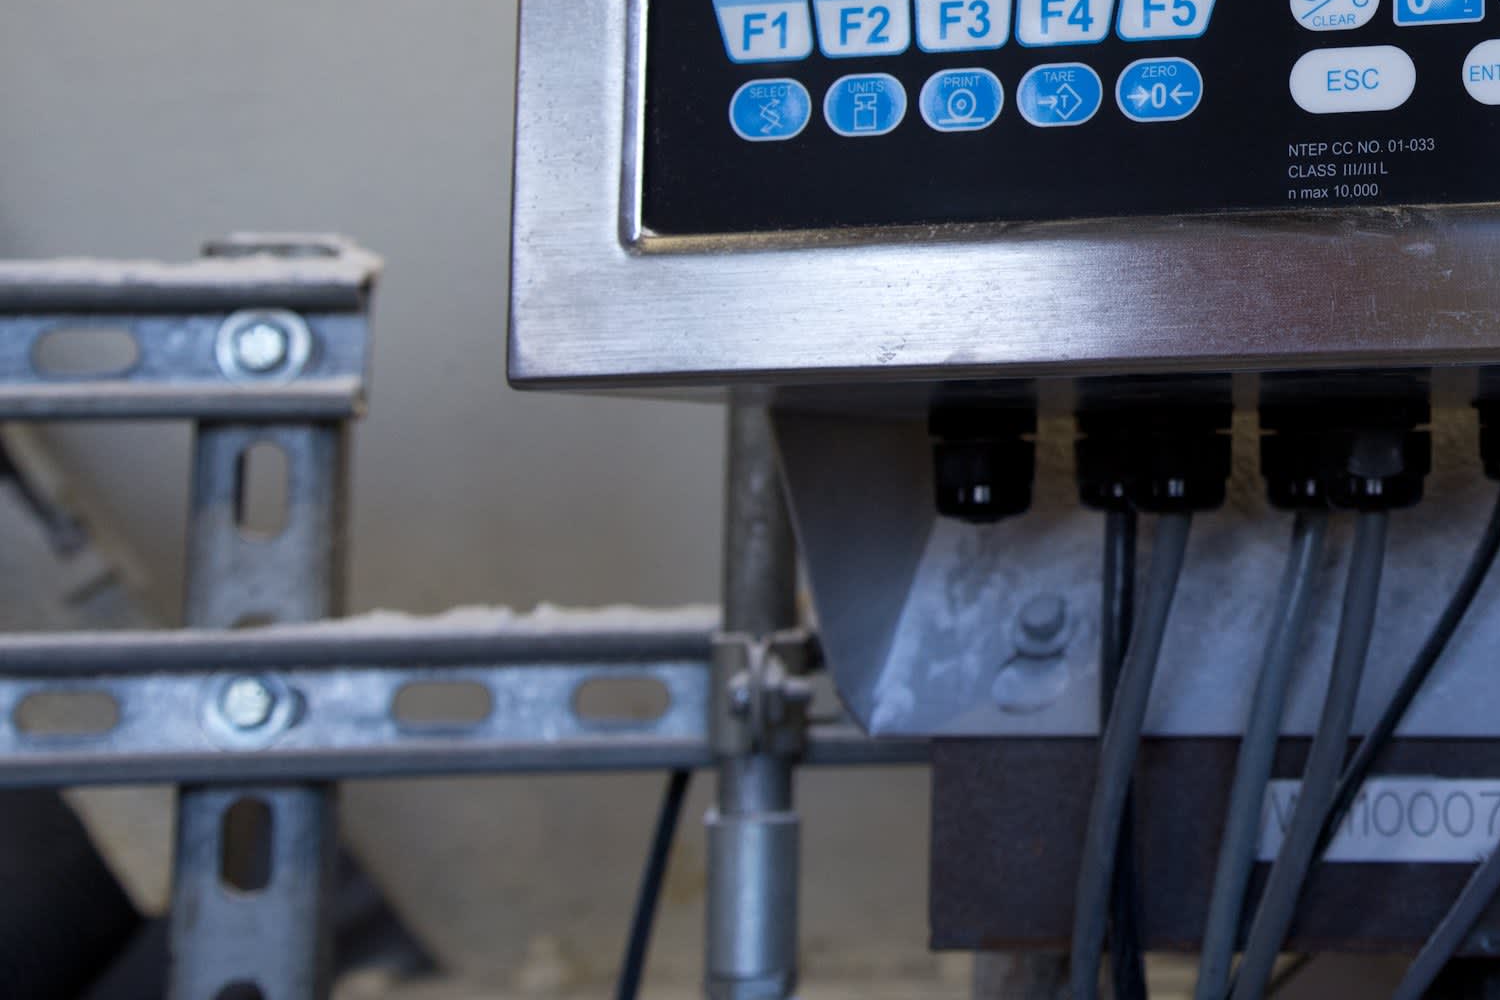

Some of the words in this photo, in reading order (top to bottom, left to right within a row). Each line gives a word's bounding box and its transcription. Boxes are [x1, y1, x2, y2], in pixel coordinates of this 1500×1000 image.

[839, 6, 890, 46] F2
[940, 0, 990, 40] F3
[1312, 13, 1356, 27] CLEAR
[743, 11, 788, 51] F1
[1043, 71, 1076, 83] TARE
[1141, 65, 1177, 78] ZERO
[943, 75, 981, 88] PRINT
[1326, 68, 1380, 91] ESC
[750, 85, 793, 98] SELECT
[847, 81, 885, 94] UNITS
[1288, 143, 1328, 157] NTEP
[1332, 142, 1353, 155] CC
[1357, 140, 1383, 154] NO.
[1388, 138, 1435, 153] 01-033
[1288, 164, 1336, 178] CLASS
[1288, 190, 1296, 199] n
[1301, 188, 1328, 199] max
[1334, 183, 1379, 198] 10,000
